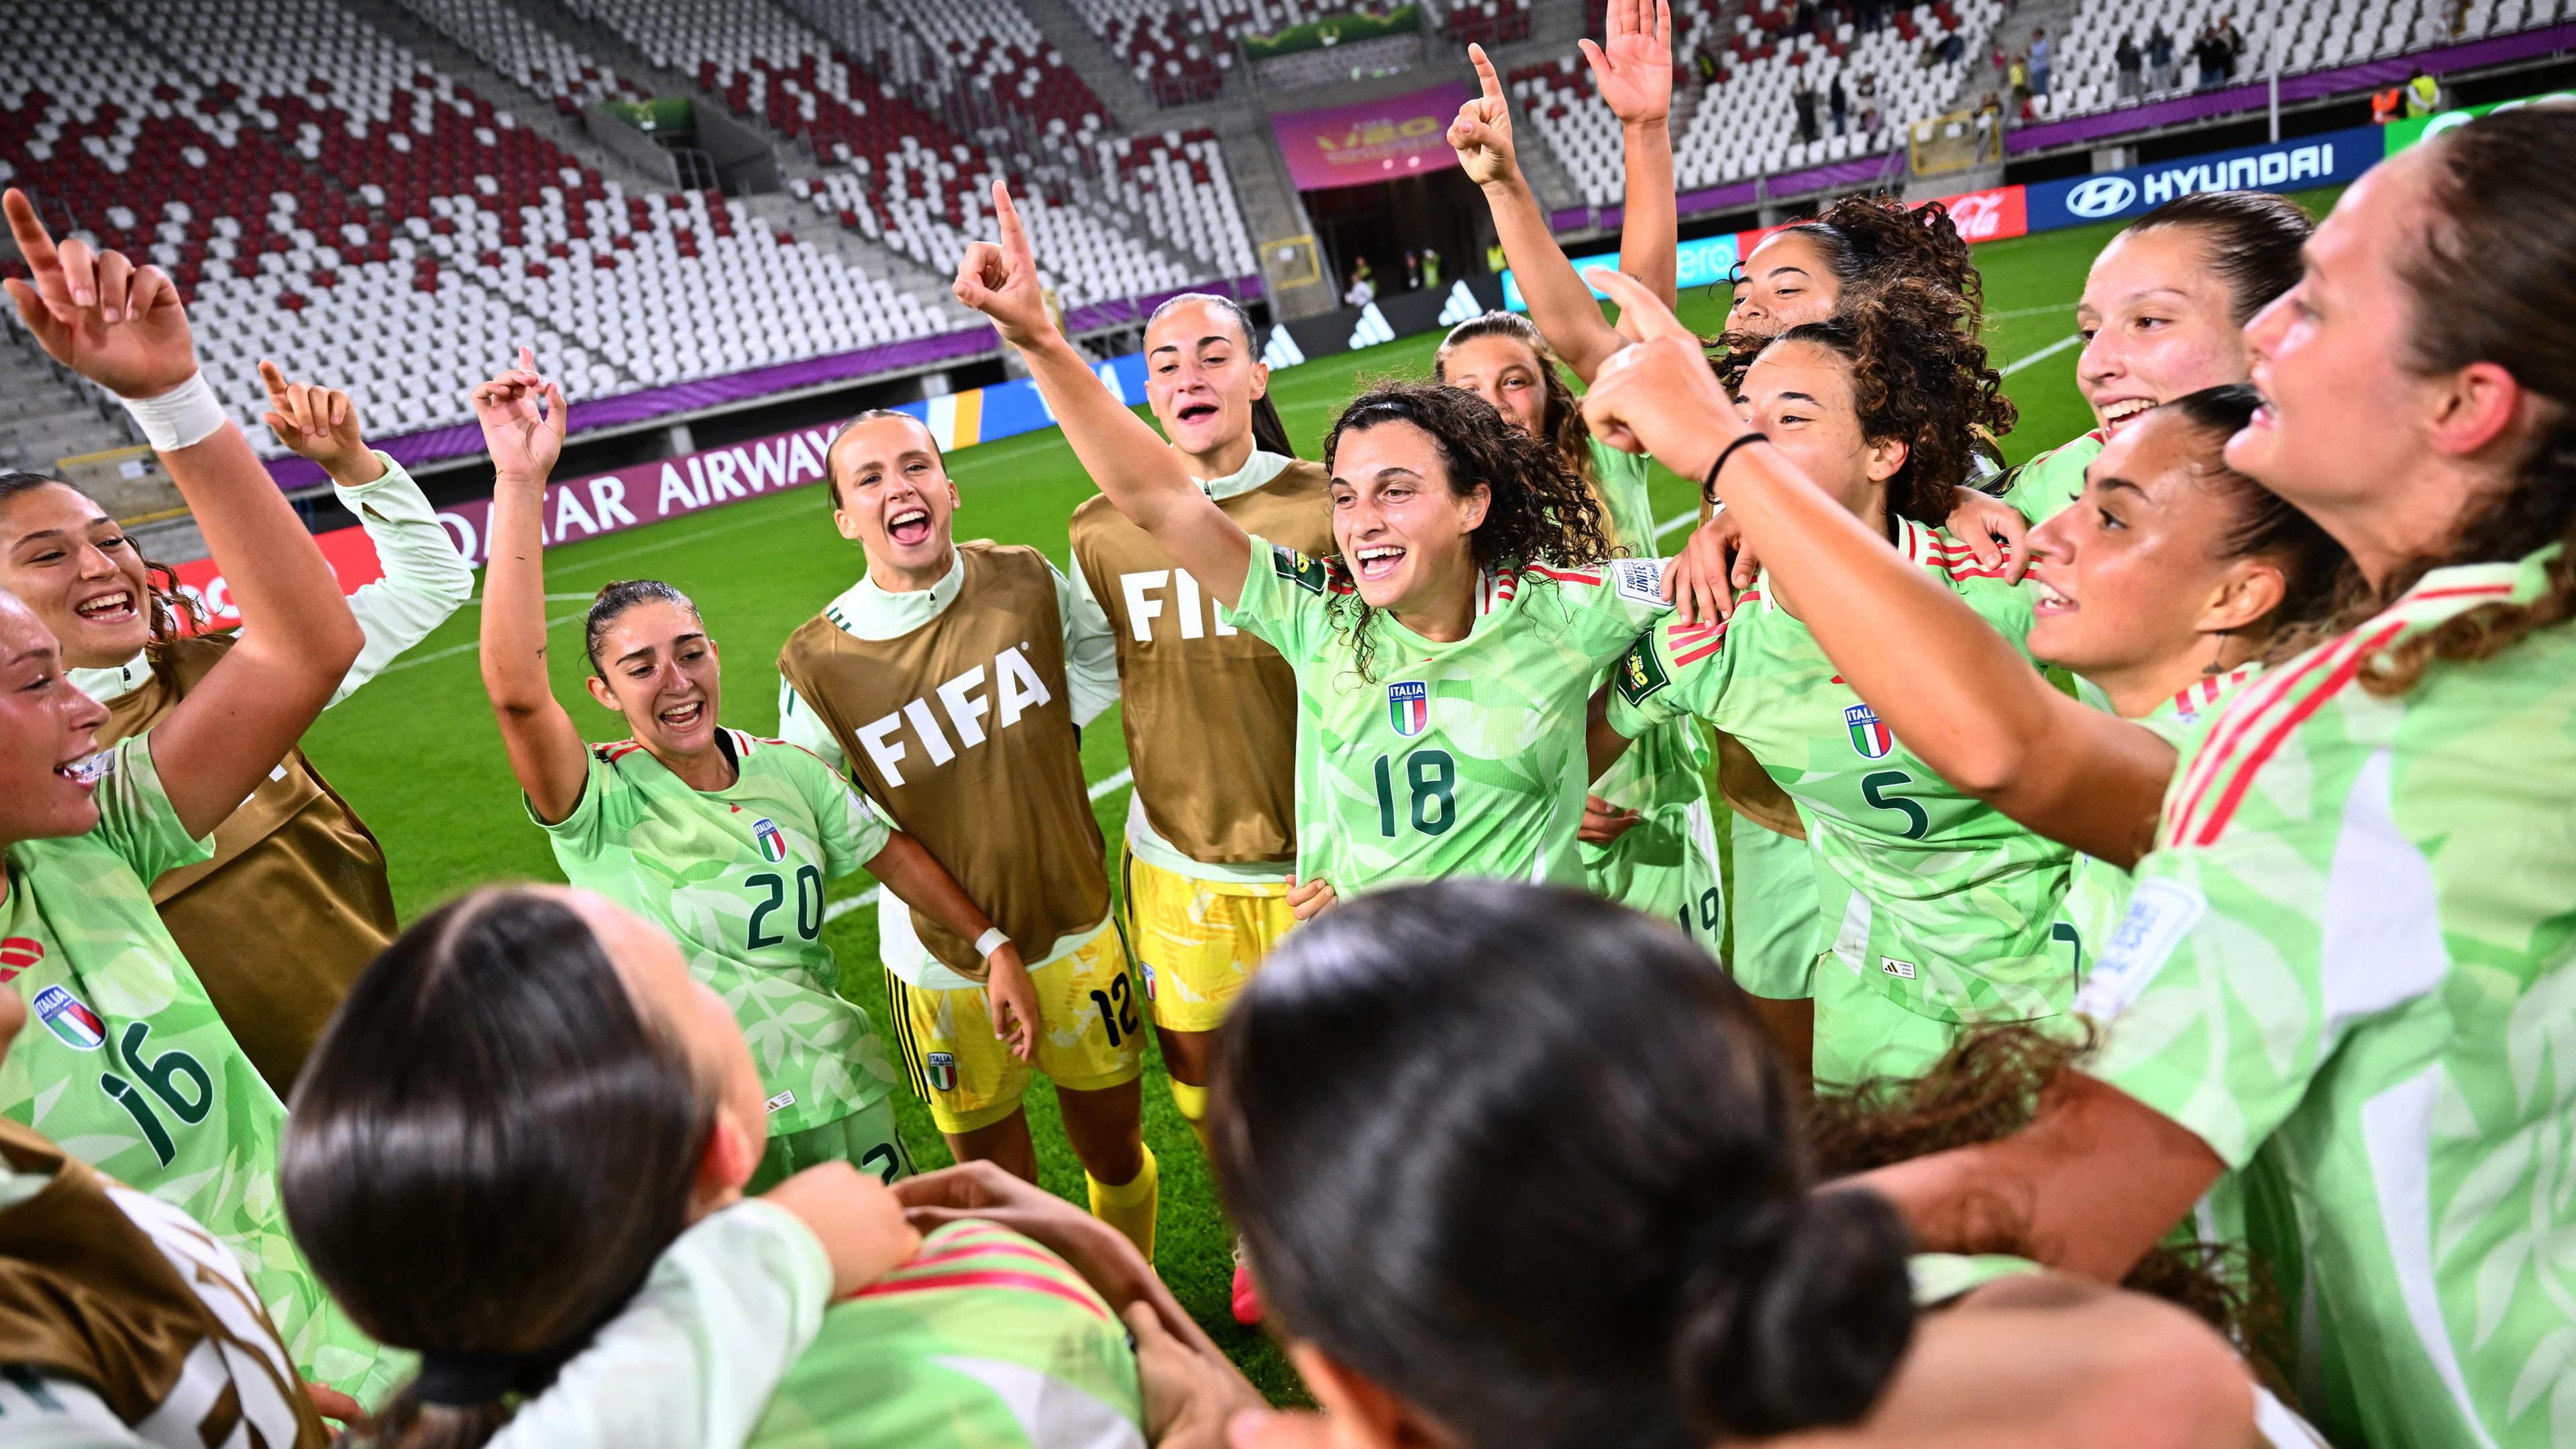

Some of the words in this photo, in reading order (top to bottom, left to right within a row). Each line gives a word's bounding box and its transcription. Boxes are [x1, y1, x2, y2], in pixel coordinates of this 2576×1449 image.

[2143, 143, 2333, 205] HYUNDAI
[1677, 243, 1735, 279] ero
[435, 476, 637, 570] QAR
[657, 425, 843, 516] AIRWAY
[1120, 568, 1238, 642] FI
[855, 646, 1051, 788] FIFA
[1390, 684, 1424, 697] ITALIA
[1846, 707, 1877, 721] ITALI
[753, 820, 774, 835] ITALIA
[1374, 749, 1456, 837] 18
[1860, 770, 1930, 840] 5
[744, 863, 824, 951] 20
[35, 989, 68, 1018] ITALIA
[1089, 971, 1138, 1048] 12
[930, 1055, 953, 1063] ITALIA
[100, 1020, 214, 1171] 16
